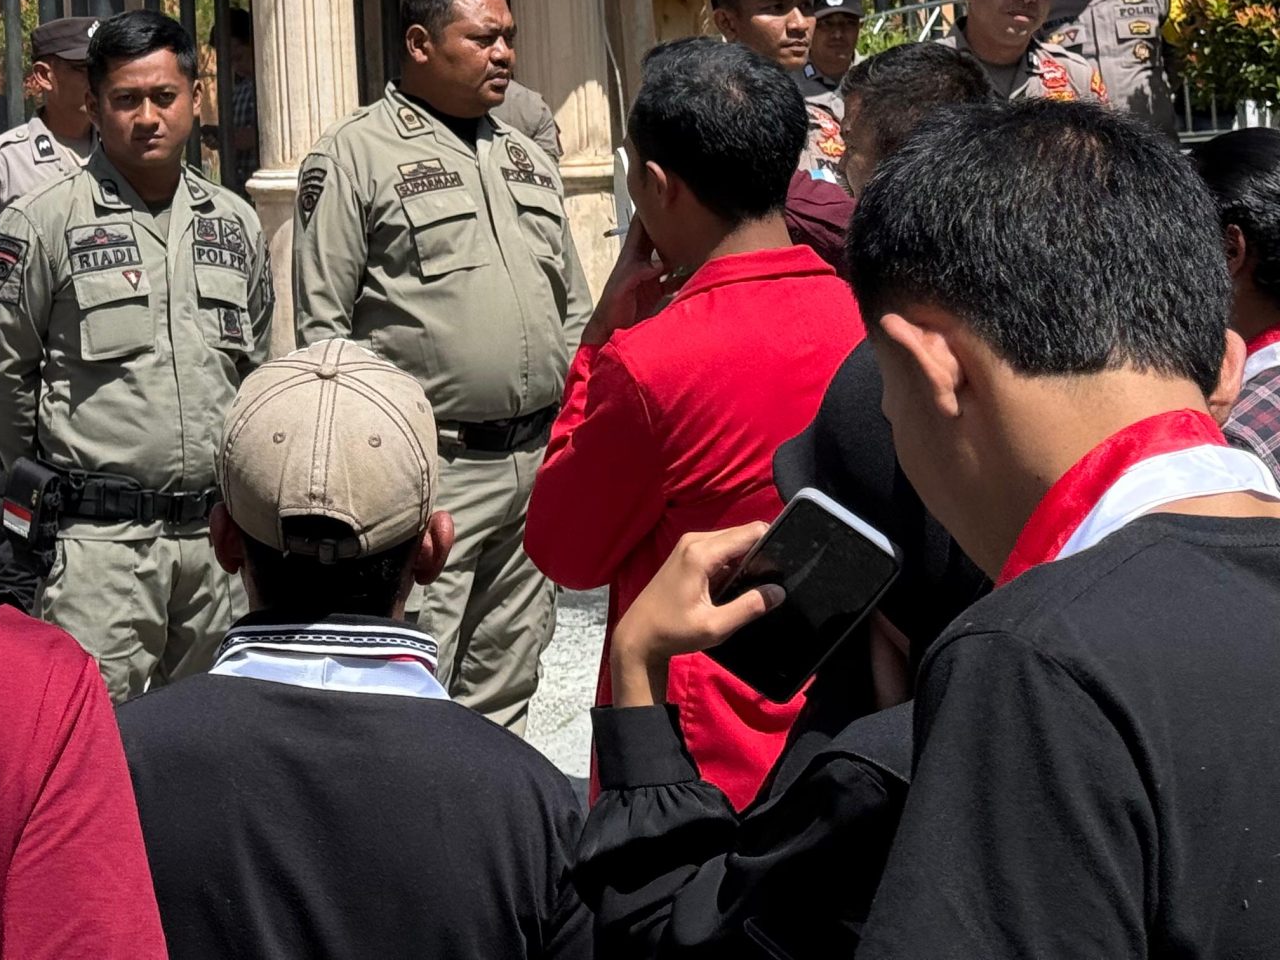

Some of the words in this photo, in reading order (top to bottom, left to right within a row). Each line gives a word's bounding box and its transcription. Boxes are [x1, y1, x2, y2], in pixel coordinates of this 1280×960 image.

[1119, 6, 1154, 17] POLRI
[78, 248, 134, 269] RIADI
[196, 247, 227, 264] POL
[229, 253, 244, 271] PP
